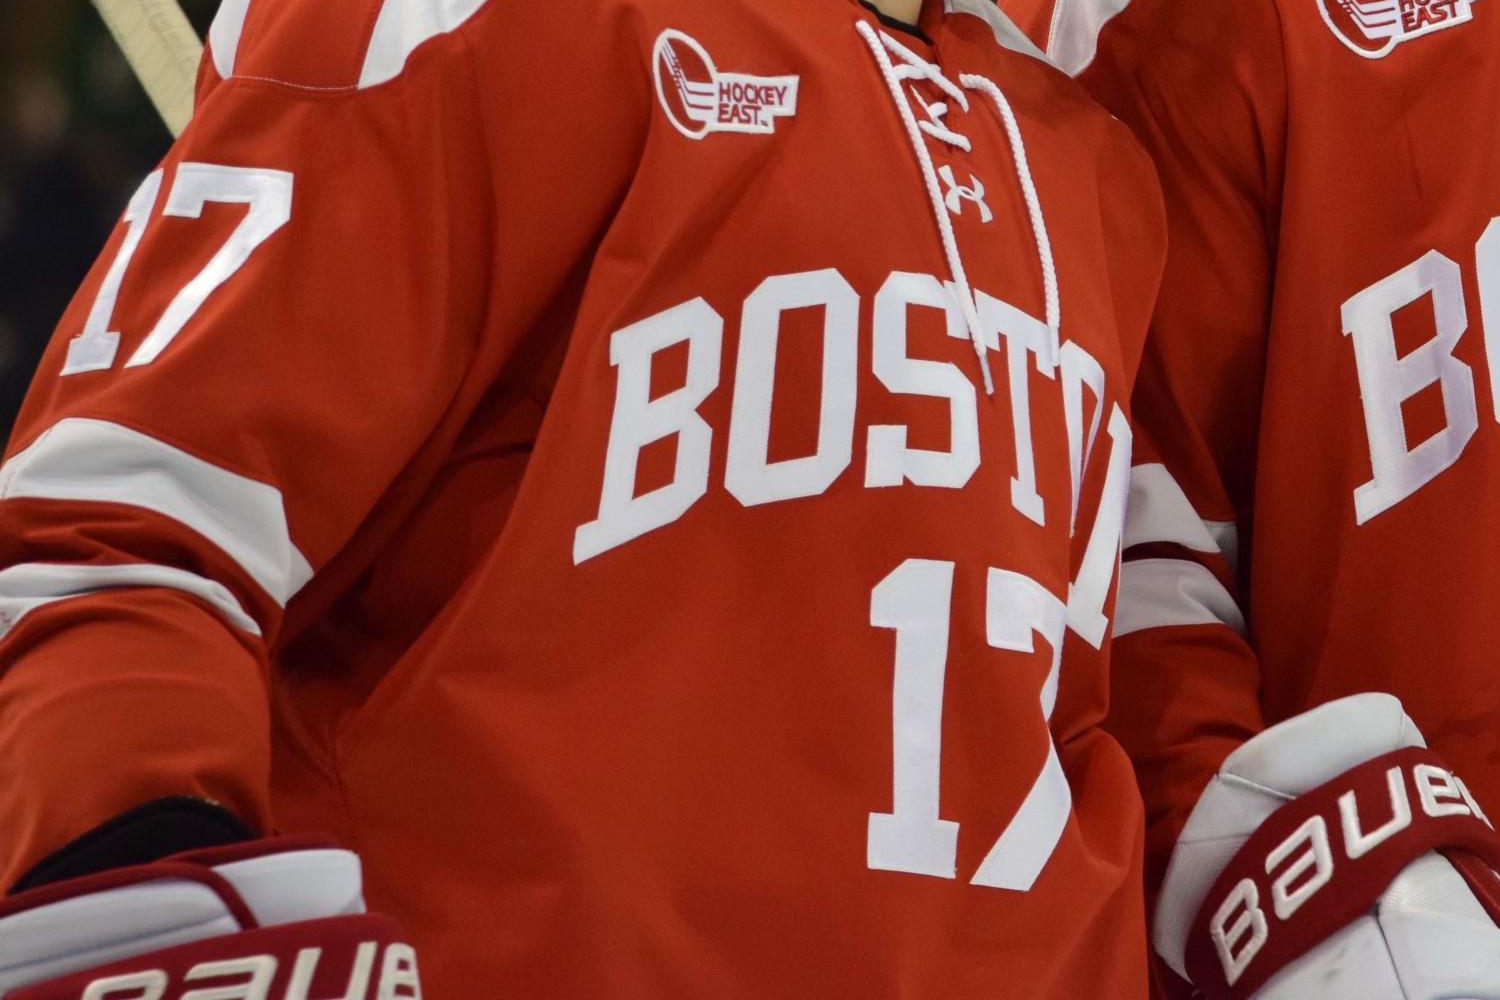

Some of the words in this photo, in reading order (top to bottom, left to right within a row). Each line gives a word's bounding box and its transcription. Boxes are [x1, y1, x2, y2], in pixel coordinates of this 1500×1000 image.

[717, 103, 762, 125] EAST
[718, 81, 787, 106] HOCKEY
[59, 161, 294, 377] 17
[866, 558, 1073, 892] 17
